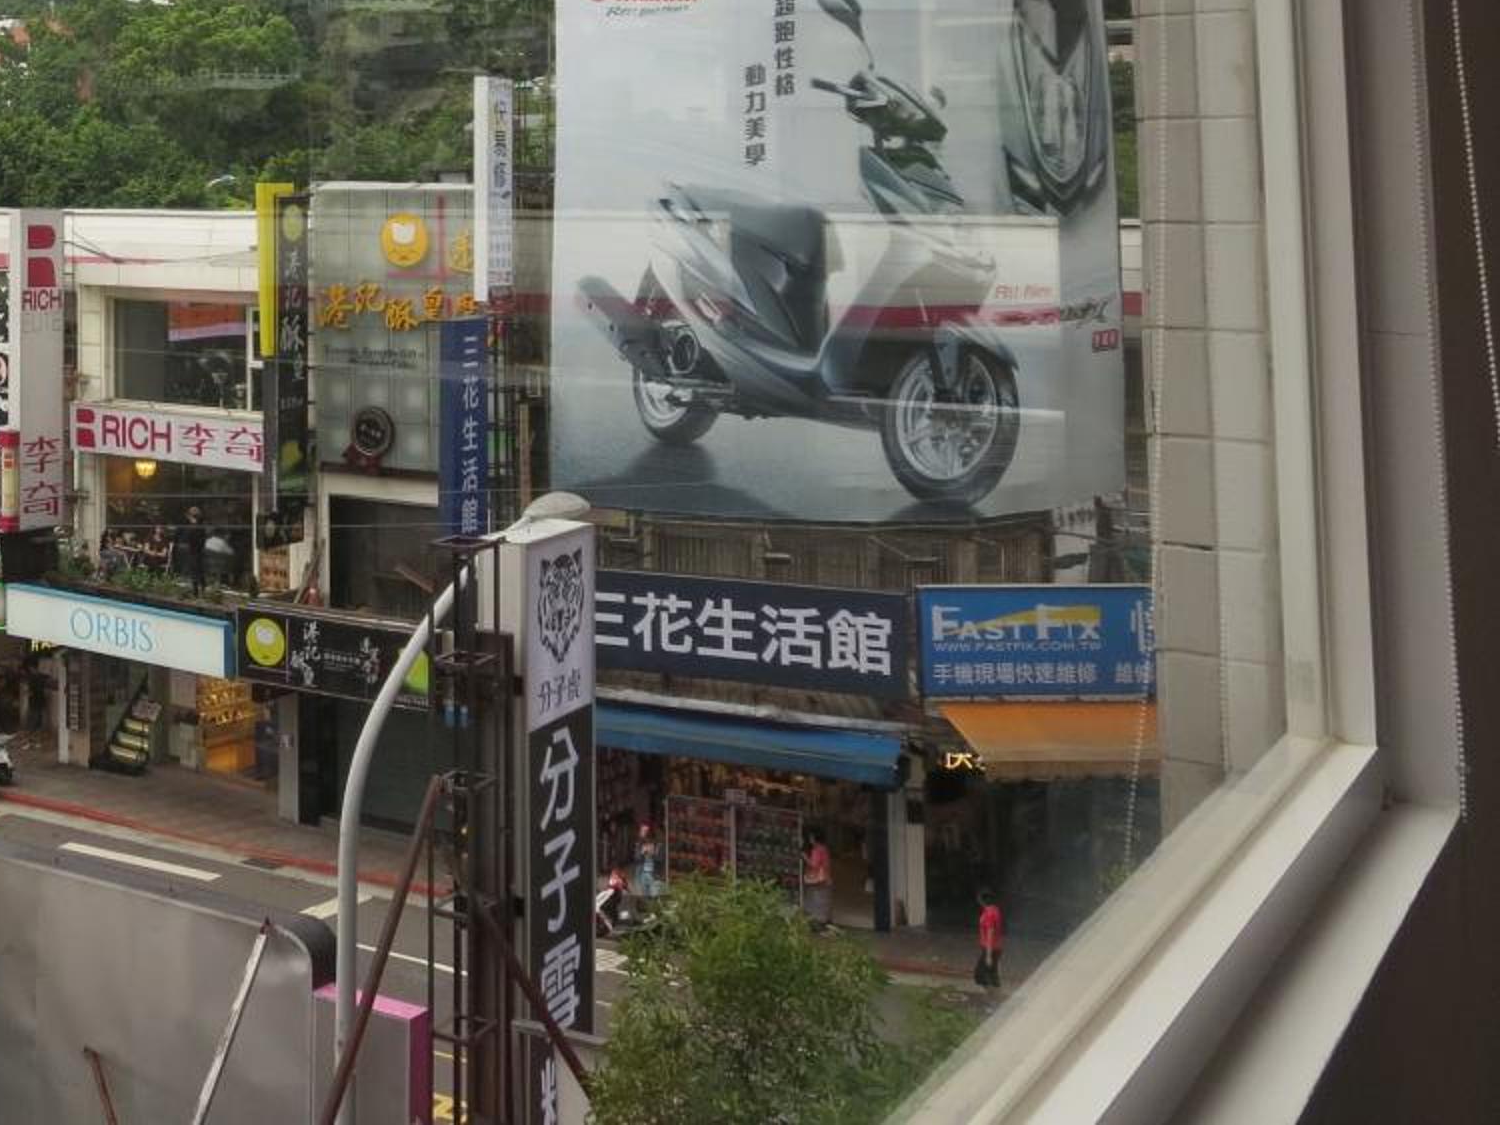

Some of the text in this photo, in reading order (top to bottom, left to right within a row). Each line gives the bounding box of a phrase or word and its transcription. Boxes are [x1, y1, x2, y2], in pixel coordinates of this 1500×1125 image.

[744, 62, 767, 166] 動力美學
[21, 288, 63, 311] RICH
[22, 435, 61, 517] 李奇
[101, 414, 172, 454] RICH
[181, 422, 263, 464] 李奇
[461, 335, 479, 535] 三花生活館
[70, 606, 155, 653] ORBIS
[595, 591, 892, 675] 三花生活館
